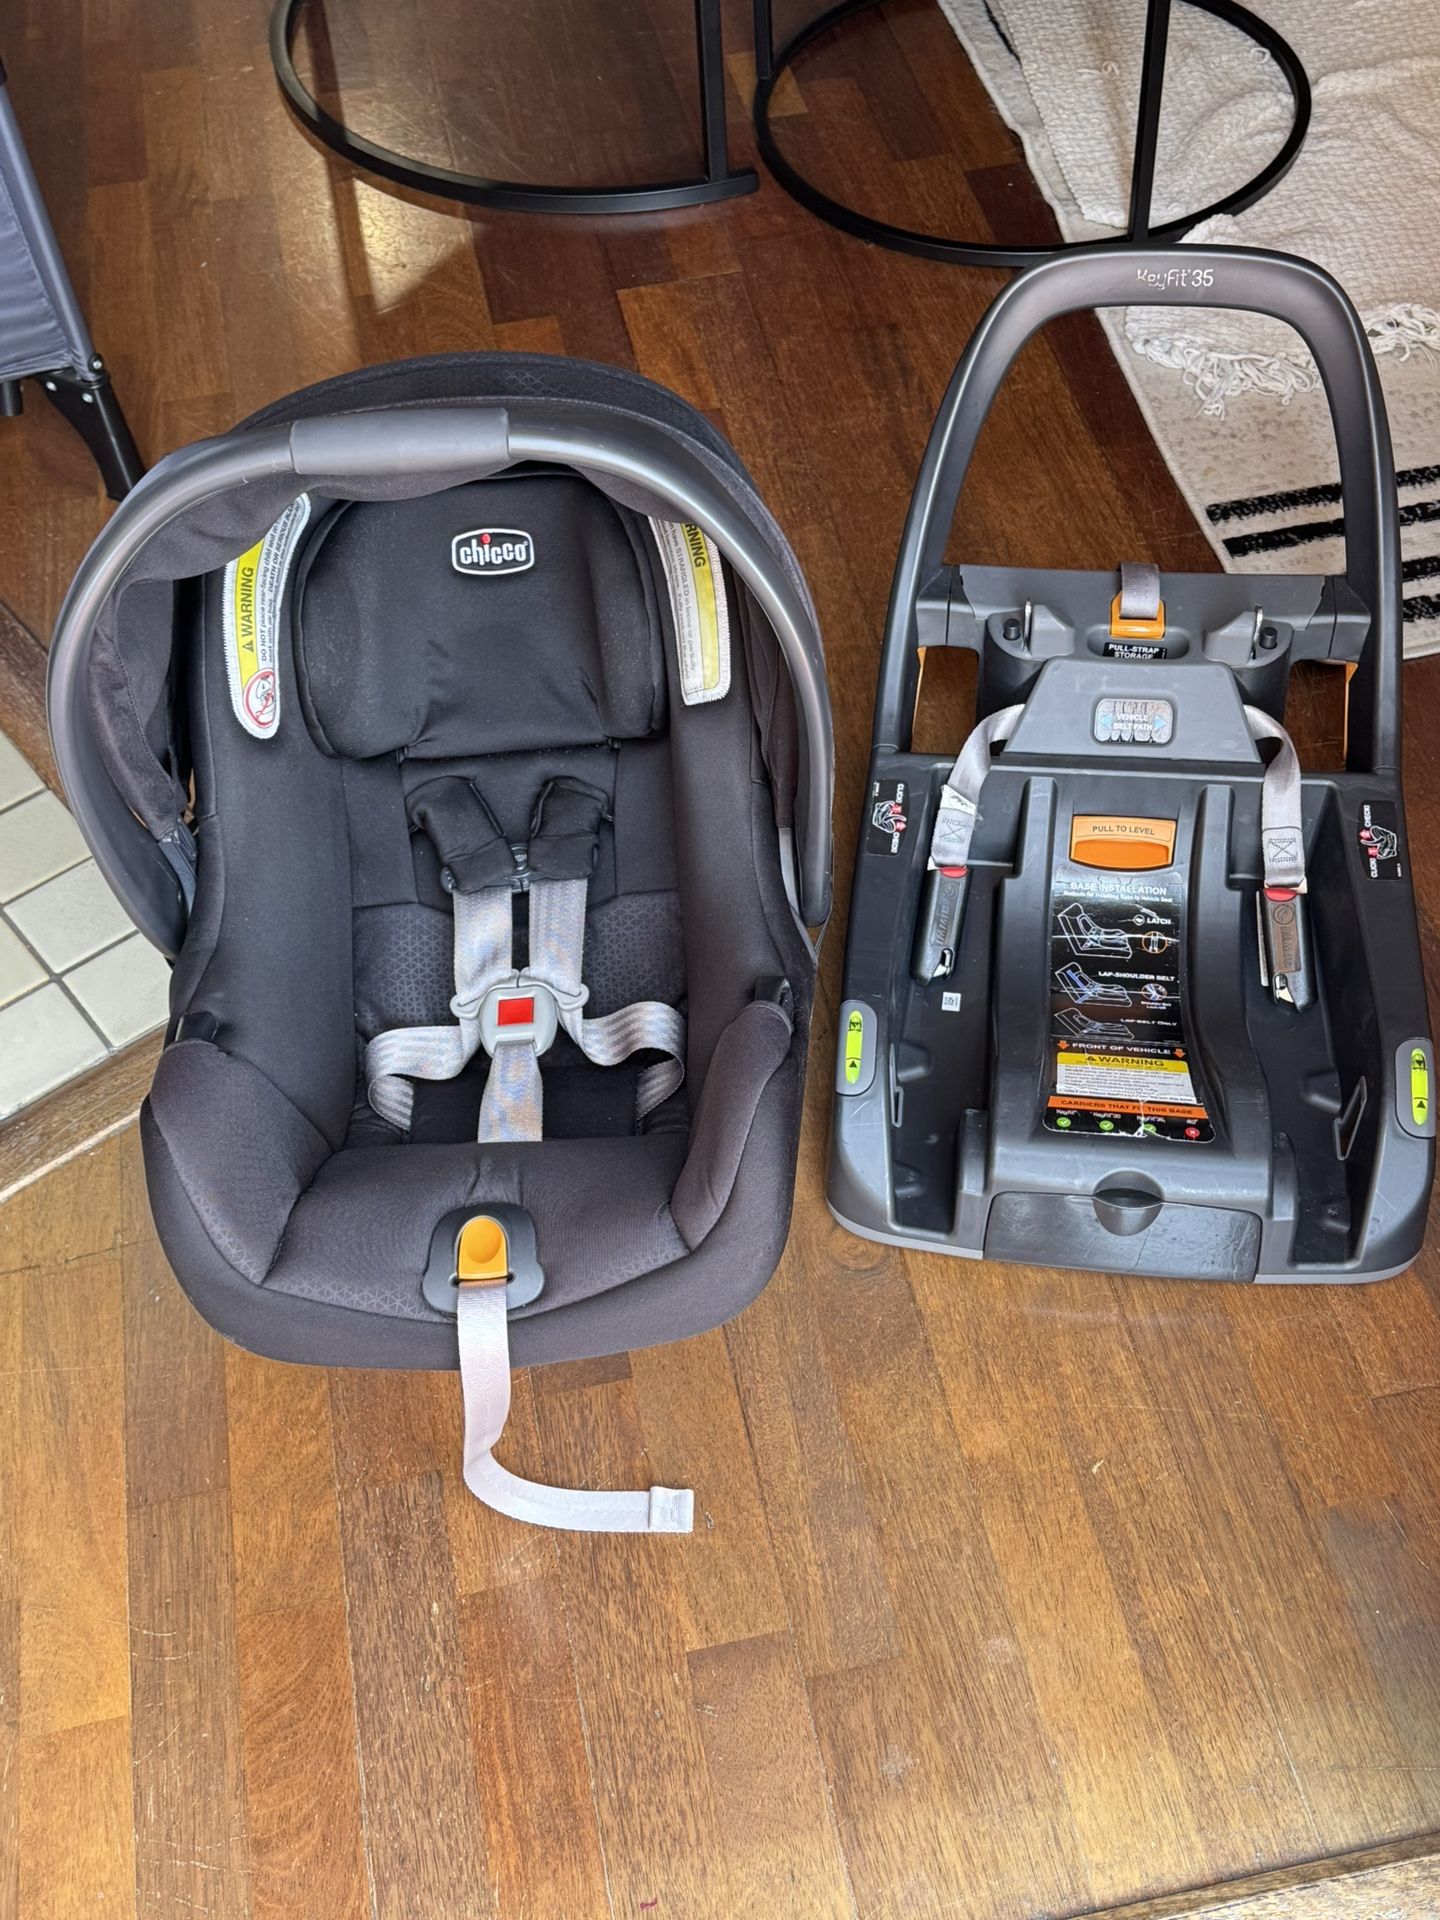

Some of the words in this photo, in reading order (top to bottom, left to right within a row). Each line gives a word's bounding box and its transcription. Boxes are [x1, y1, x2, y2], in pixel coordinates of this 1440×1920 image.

[1191, 268, 1214, 287] 35
[266, 533, 276, 549] seat
[274, 520, 289, 553] SERIOUS
[459, 533, 503, 566] chicco
[685, 523, 706, 568] RNING
[262, 549, 272, 566] child
[271, 552, 280, 565] OR
[267, 565, 277, 593] DEATH
[675, 547, 690, 596] STRANGLED
[259, 566, 271, 606] rear-facing
[241, 566, 254, 638] WARNING
[259, 606, 267, 628] place
[260, 649, 267, 662] DO
[1108, 643, 1160, 654] PULL-STRAP
[1117, 713, 1148, 721] VEHICLE
[1113, 723, 1132, 731] BELT
[1133, 723, 1153, 732] PATH
[1092, 825, 1114, 833] PULL
[1116, 825, 1127, 833] TO
[1129, 826, 1156, 836] LEVEL
[1070, 881, 1099, 891] BASE
[1099, 883, 1168, 895] INSTALLATION
[1146, 917, 1172, 925] LATCH
[1098, 971, 1155, 980] LAP-SHOULDER
[1072, 1042, 1108, 1051] FRONT
[1126, 1045, 1171, 1055] VEHICLE
[1098, 1055, 1165, 1067] WARNING
[1061, 1099, 1106, 1109] CARRIERS
[1107, 1102, 1130, 1111] THAT
[1147, 1105, 1167, 1113] THIS
[1168, 1107, 1193, 1115] BASE
